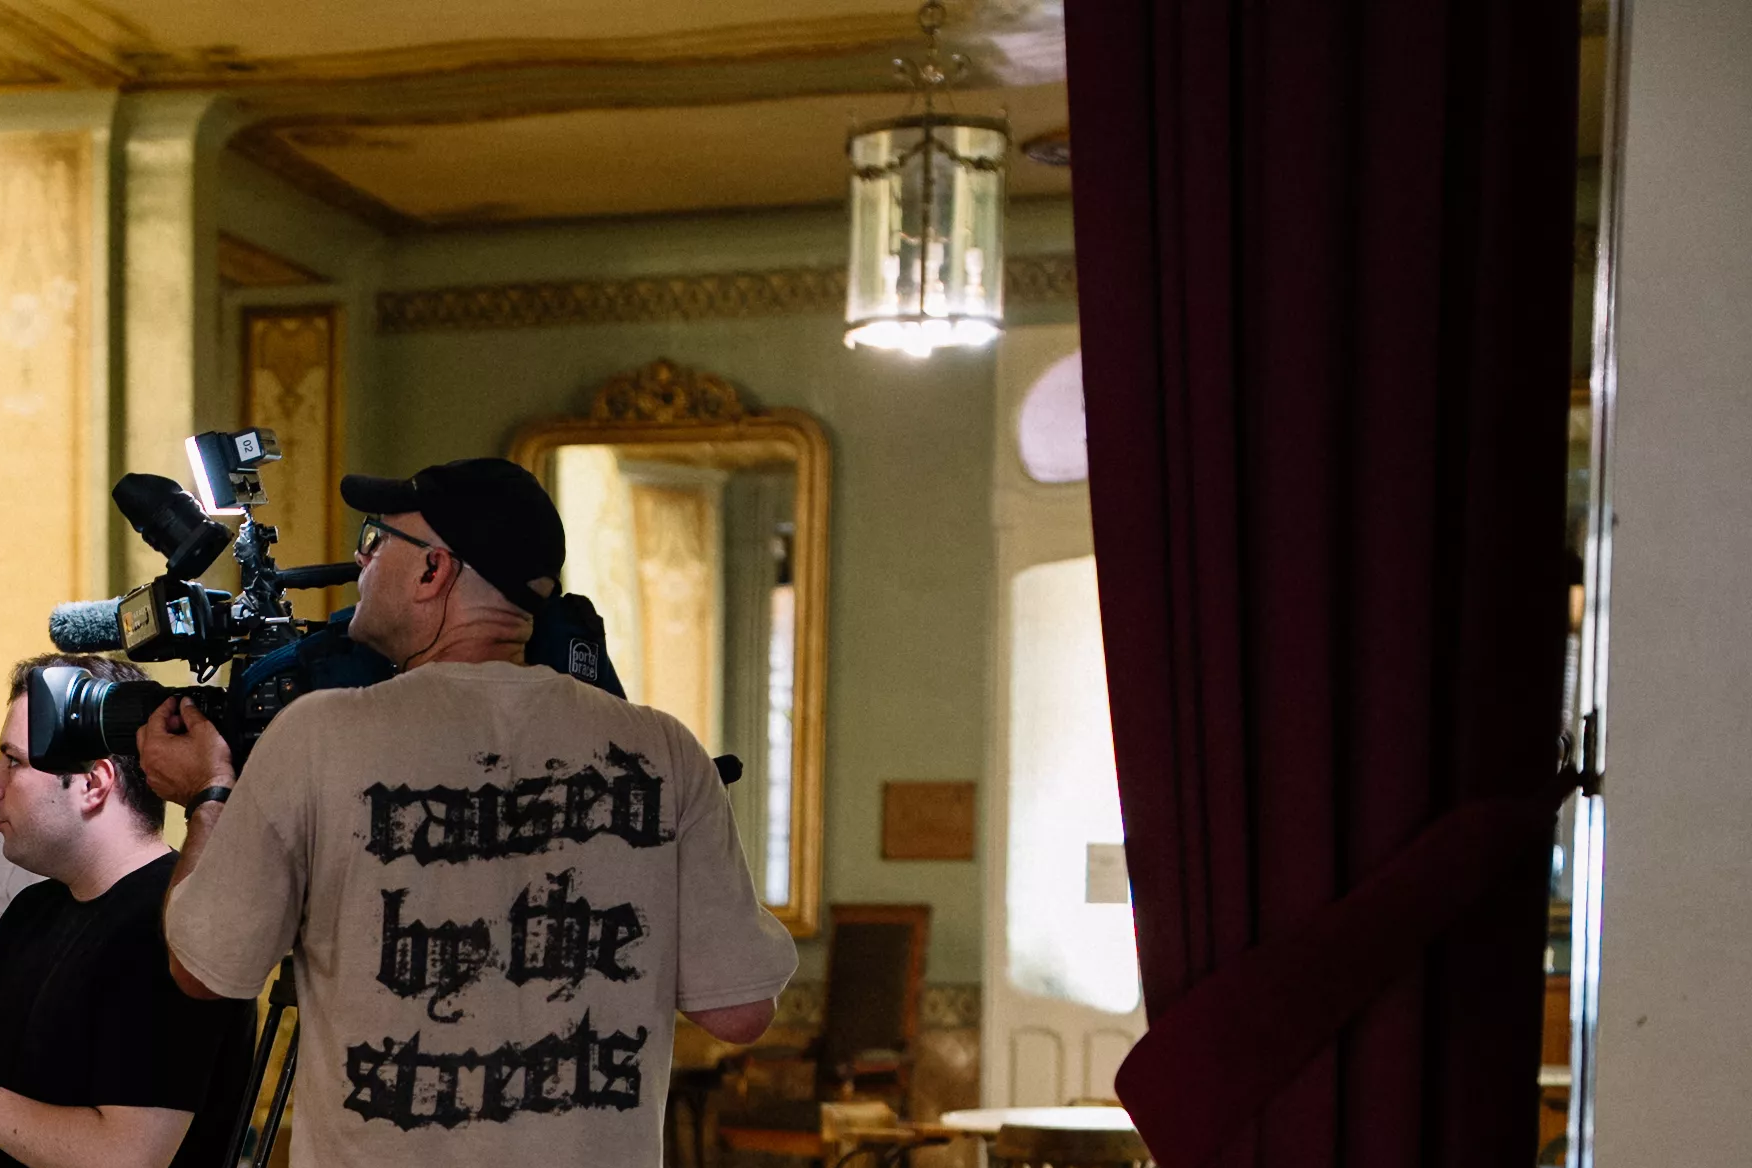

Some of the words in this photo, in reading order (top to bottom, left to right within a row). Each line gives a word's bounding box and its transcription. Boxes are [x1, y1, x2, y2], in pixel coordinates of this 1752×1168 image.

[243, 439, 254, 453] 02
[572, 660, 595, 678] brace
[364, 742, 676, 866] raised
[376, 887, 493, 1023] by
[506, 867, 649, 1001] the
[343, 1007, 647, 1132] streets
